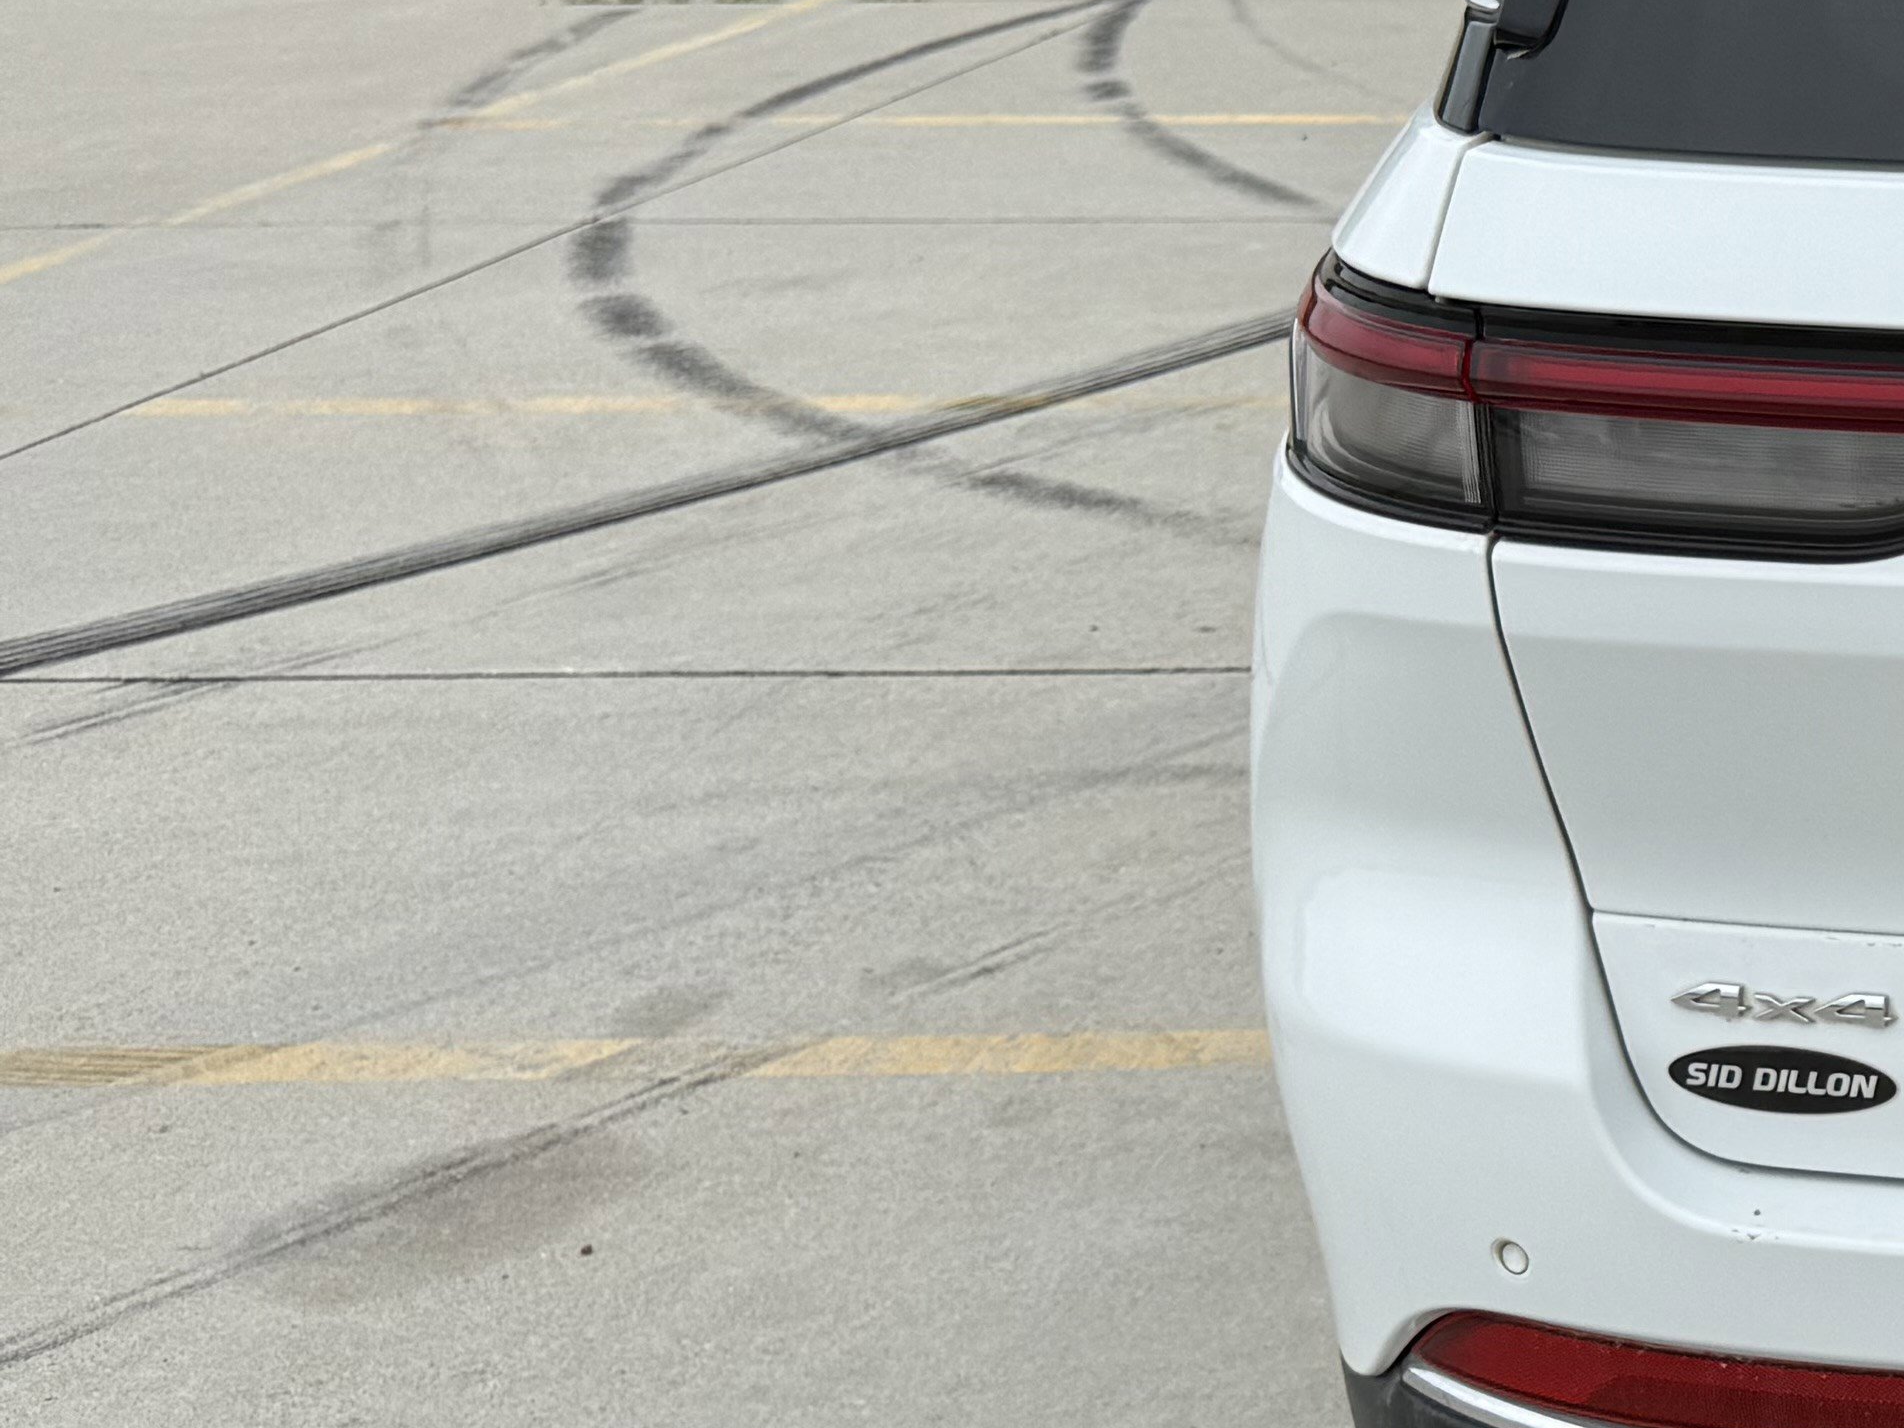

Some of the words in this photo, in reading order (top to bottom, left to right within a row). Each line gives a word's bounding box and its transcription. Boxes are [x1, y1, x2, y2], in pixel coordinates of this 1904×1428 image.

[1670, 981, 1899, 1028] 4x4
[1686, 1062, 1742, 1089] SID
[1753, 1067, 1878, 1099] DILLON
